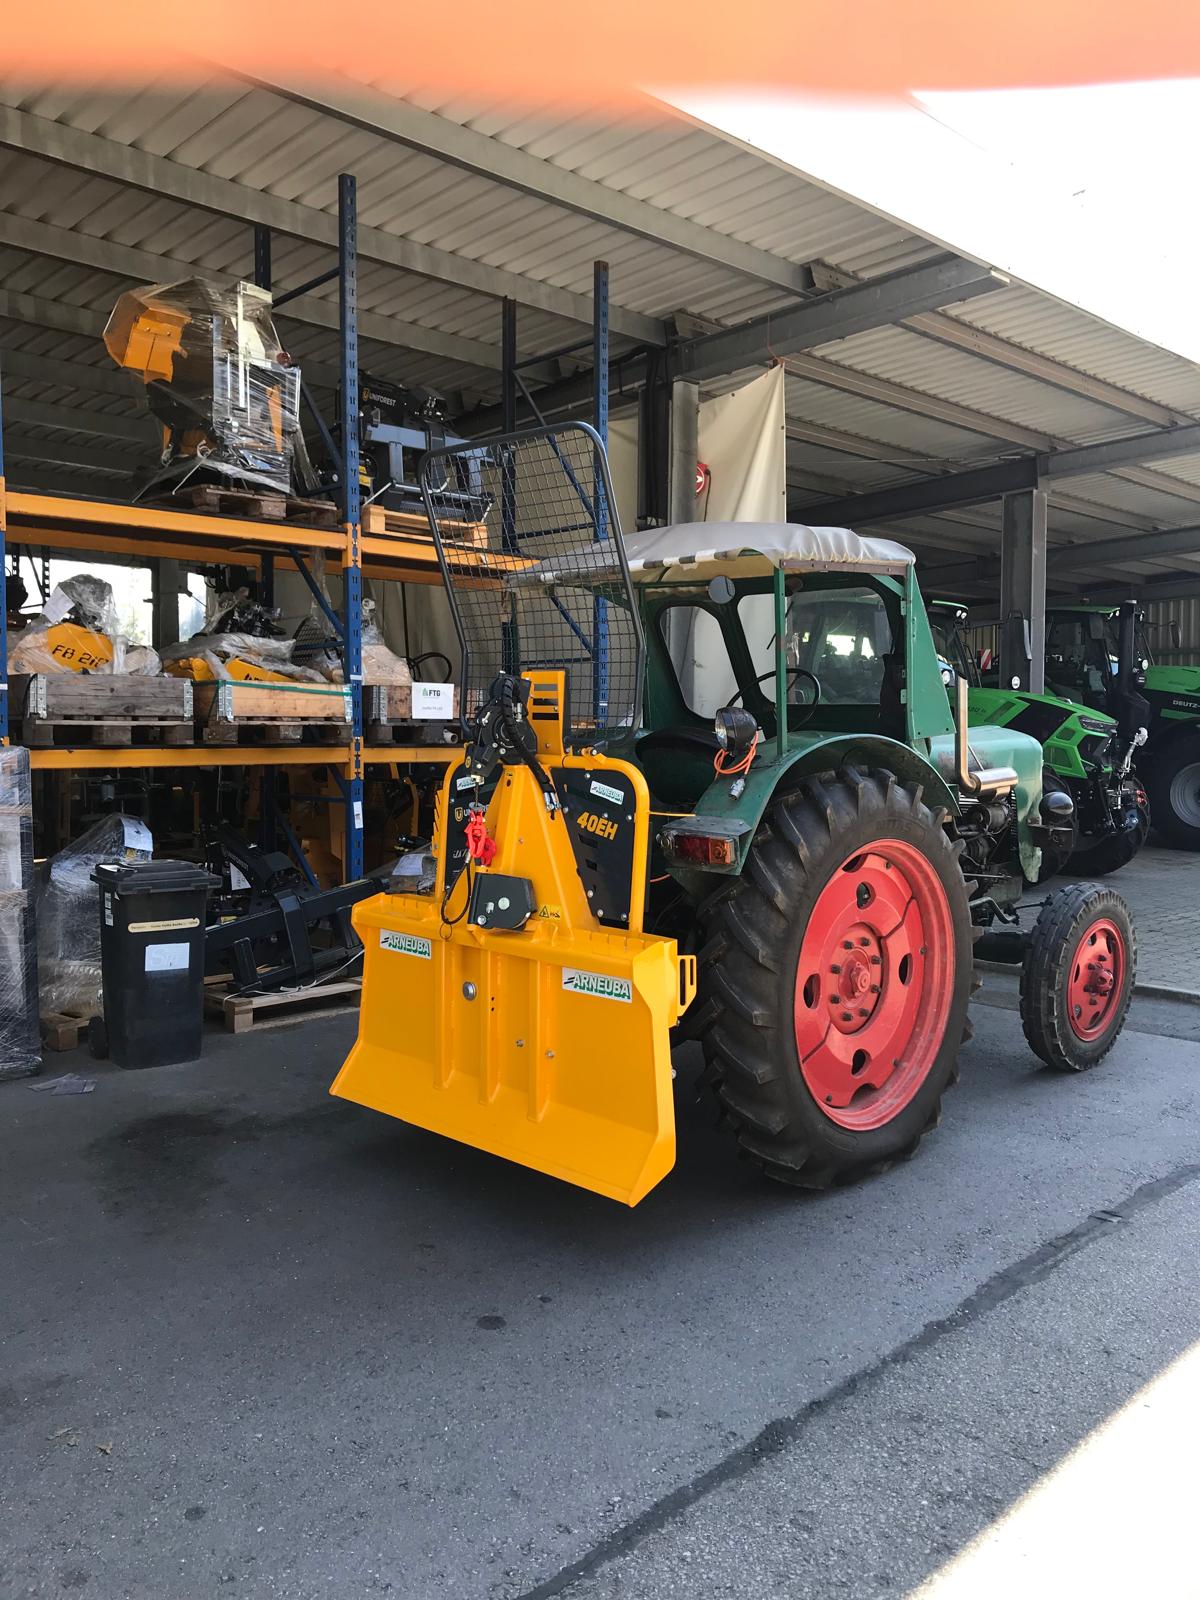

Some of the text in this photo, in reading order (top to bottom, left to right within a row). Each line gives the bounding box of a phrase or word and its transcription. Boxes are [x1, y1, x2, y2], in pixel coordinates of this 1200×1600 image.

[52, 644, 75, 660] FB
[428, 689, 441, 697] FTG
[577, 811, 618, 841] 40EH
[388, 933, 430, 957] ARNEUBA
[573, 971, 631, 1000] ARNEUBA
